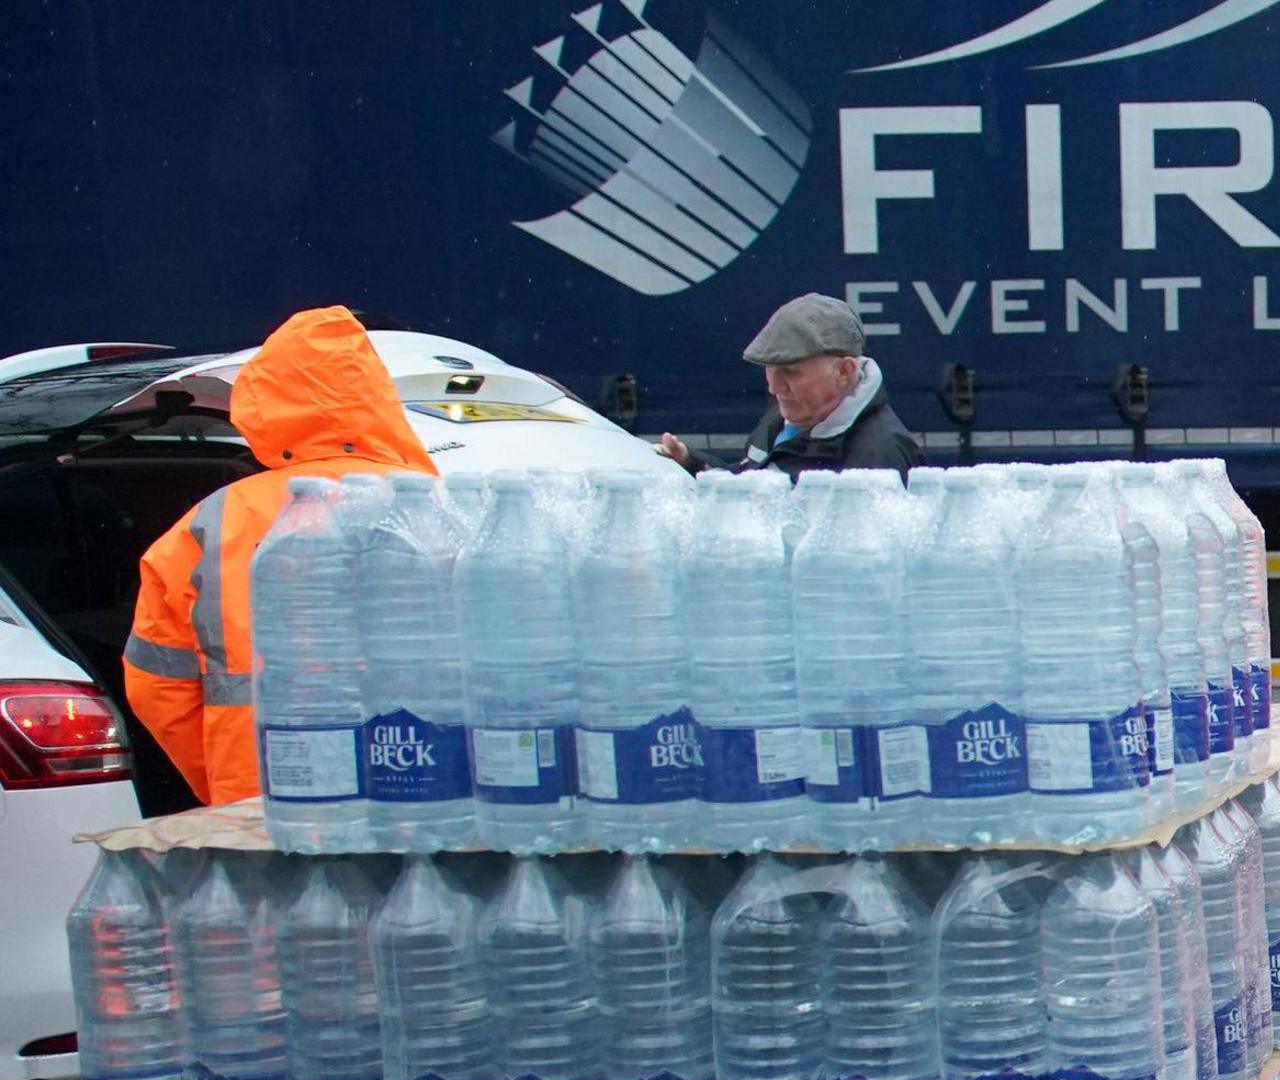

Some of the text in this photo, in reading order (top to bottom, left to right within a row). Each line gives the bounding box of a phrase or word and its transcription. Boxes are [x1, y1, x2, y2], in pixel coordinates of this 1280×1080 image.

[846, 277, 1202, 335] EVENT
[374, 725, 423, 745] GILL
[963, 719, 1012, 741] GILL
[370, 743, 437, 771] BECK
[956, 735, 1021, 765] BECK
